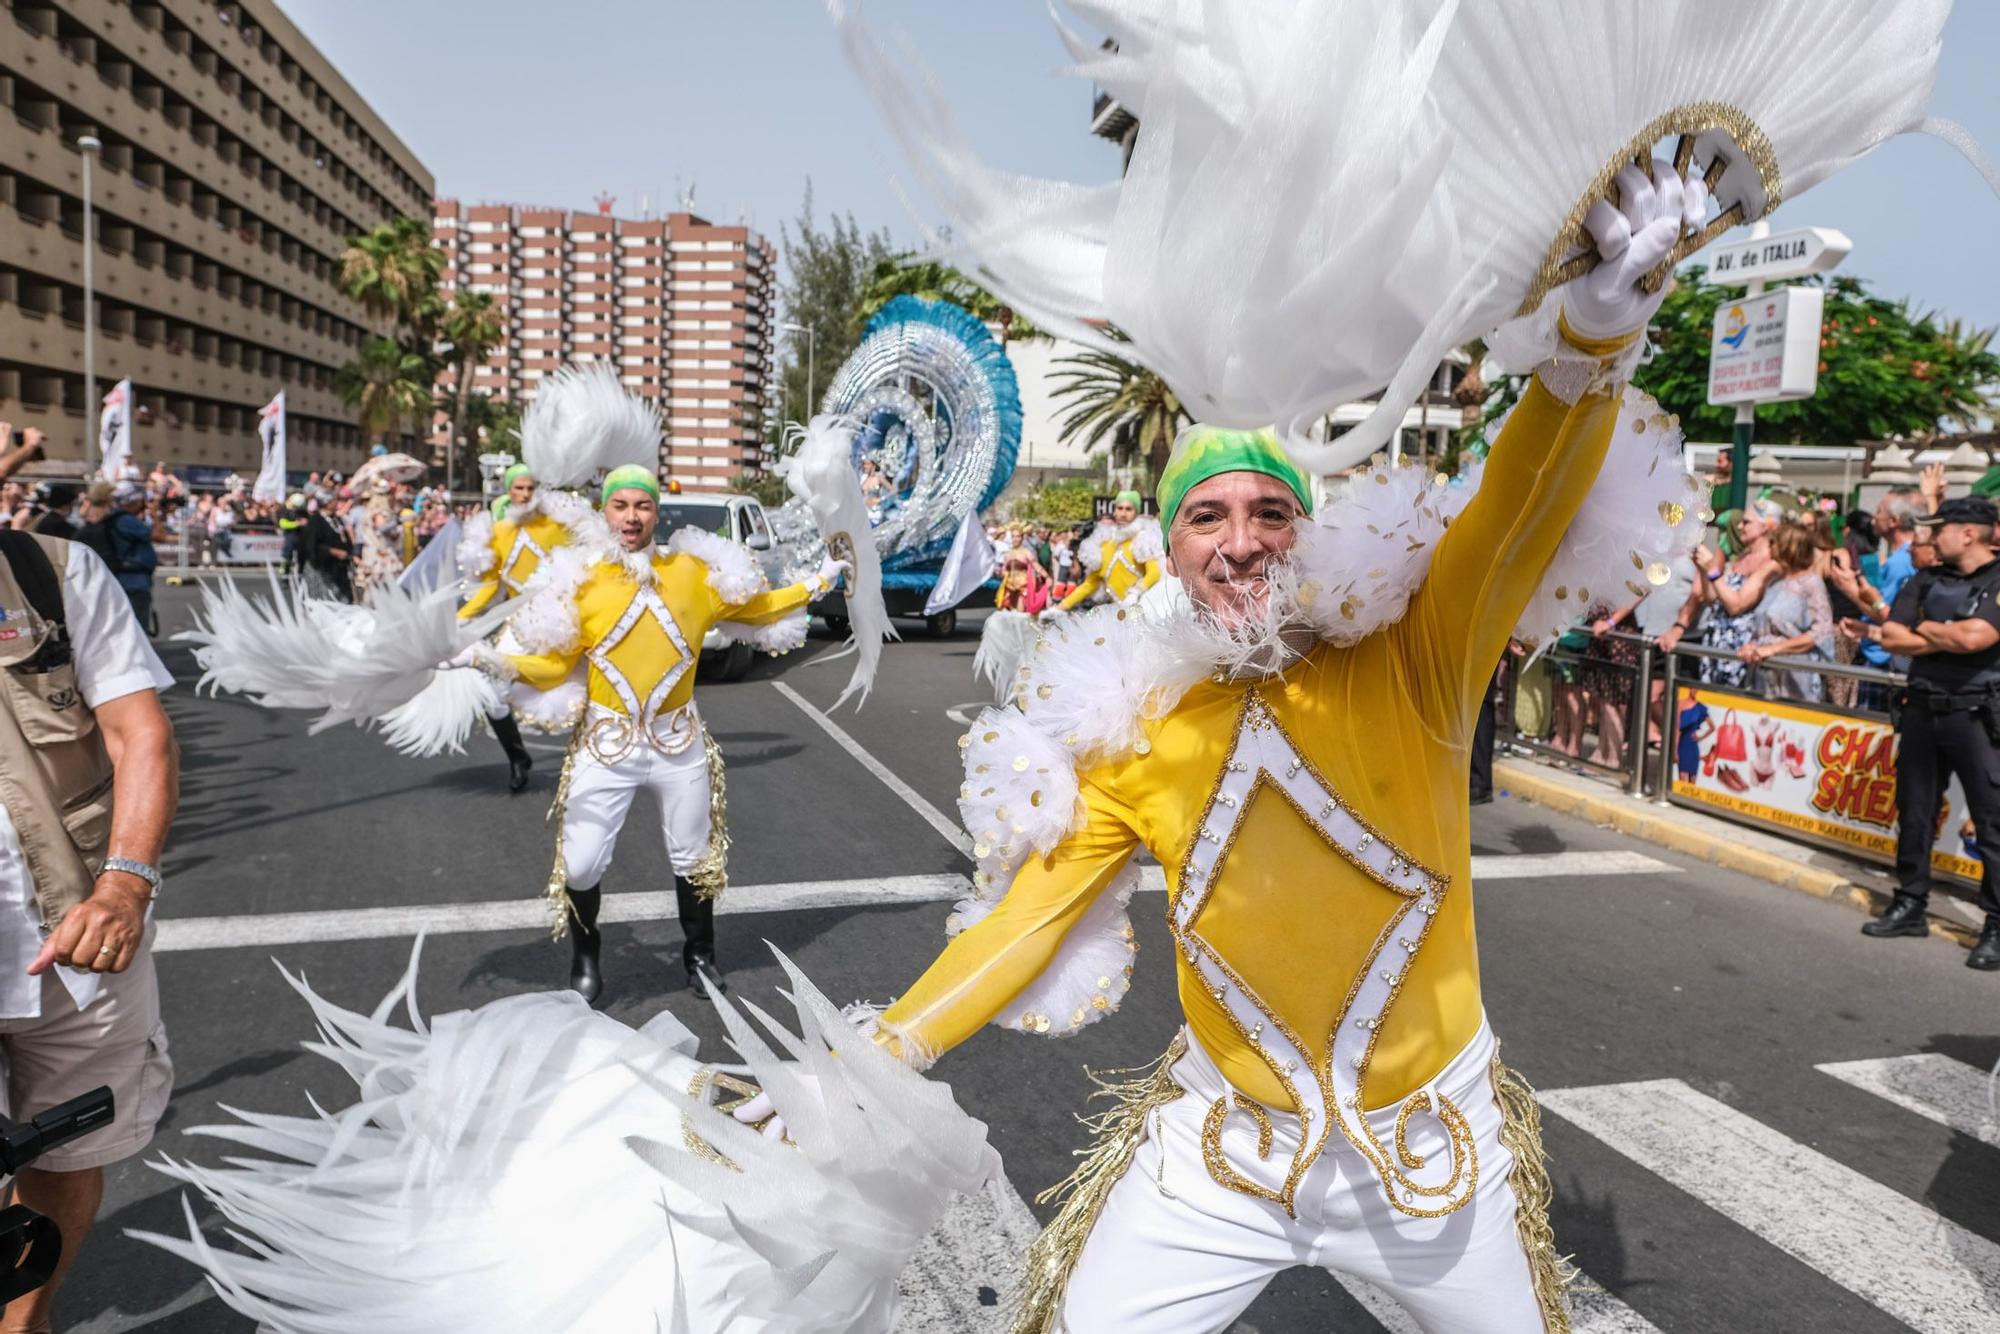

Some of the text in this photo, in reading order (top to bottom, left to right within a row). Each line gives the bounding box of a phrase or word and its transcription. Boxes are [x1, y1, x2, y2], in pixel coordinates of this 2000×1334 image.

[1716, 239, 1806, 271] AV. de ITALIA
[1818, 723, 1898, 778] CHA
[1812, 768, 1898, 826] SHE
